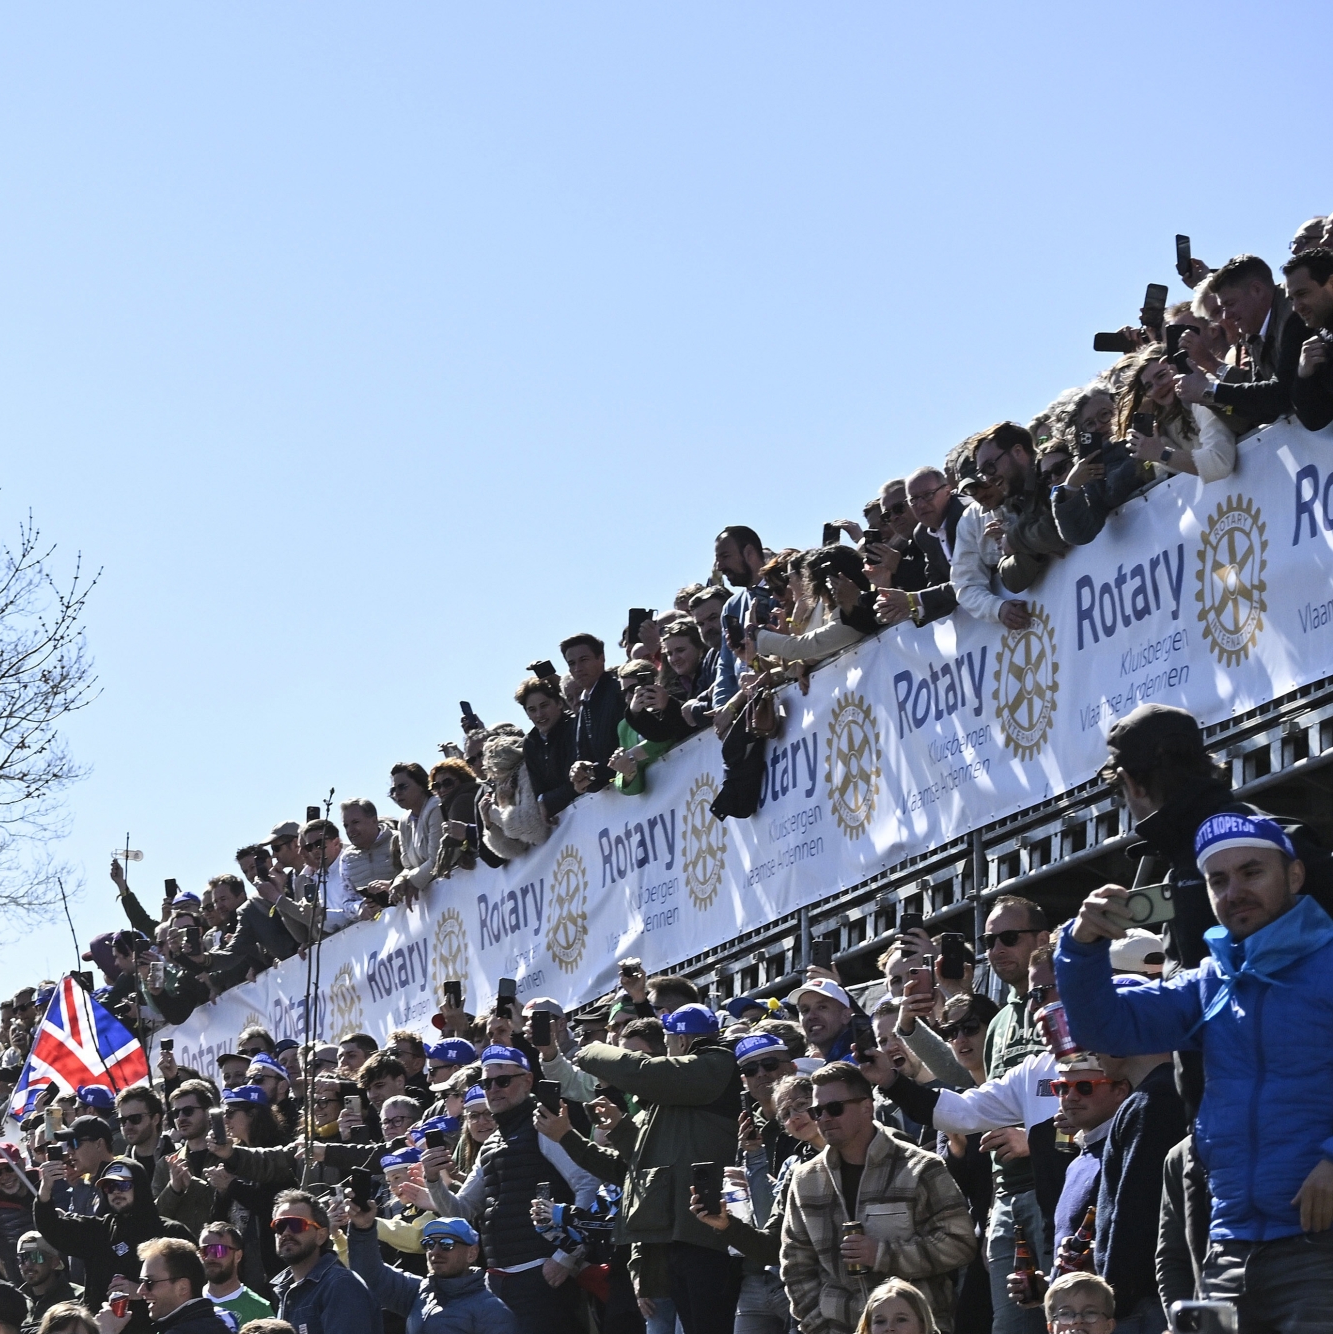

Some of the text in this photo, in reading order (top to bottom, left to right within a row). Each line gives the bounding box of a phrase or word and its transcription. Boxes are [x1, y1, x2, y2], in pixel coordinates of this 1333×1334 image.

[1213, 514, 1249, 540] ROTARY
[1010, 616, 1041, 643] RORY
[1076, 543, 1184, 651] Rotary
[1120, 627, 1189, 678] Kluisbergen
[893, 646, 988, 740] Rotary
[1080, 664, 1190, 732] Vlaamse Ardennen
[759, 732, 818, 810] otary
[598, 808, 676, 889] Rotary
[1212, 815, 1255, 836] KOPETJE
[477, 878, 544, 950] Rotary
[367, 938, 428, 1002] Rotary
